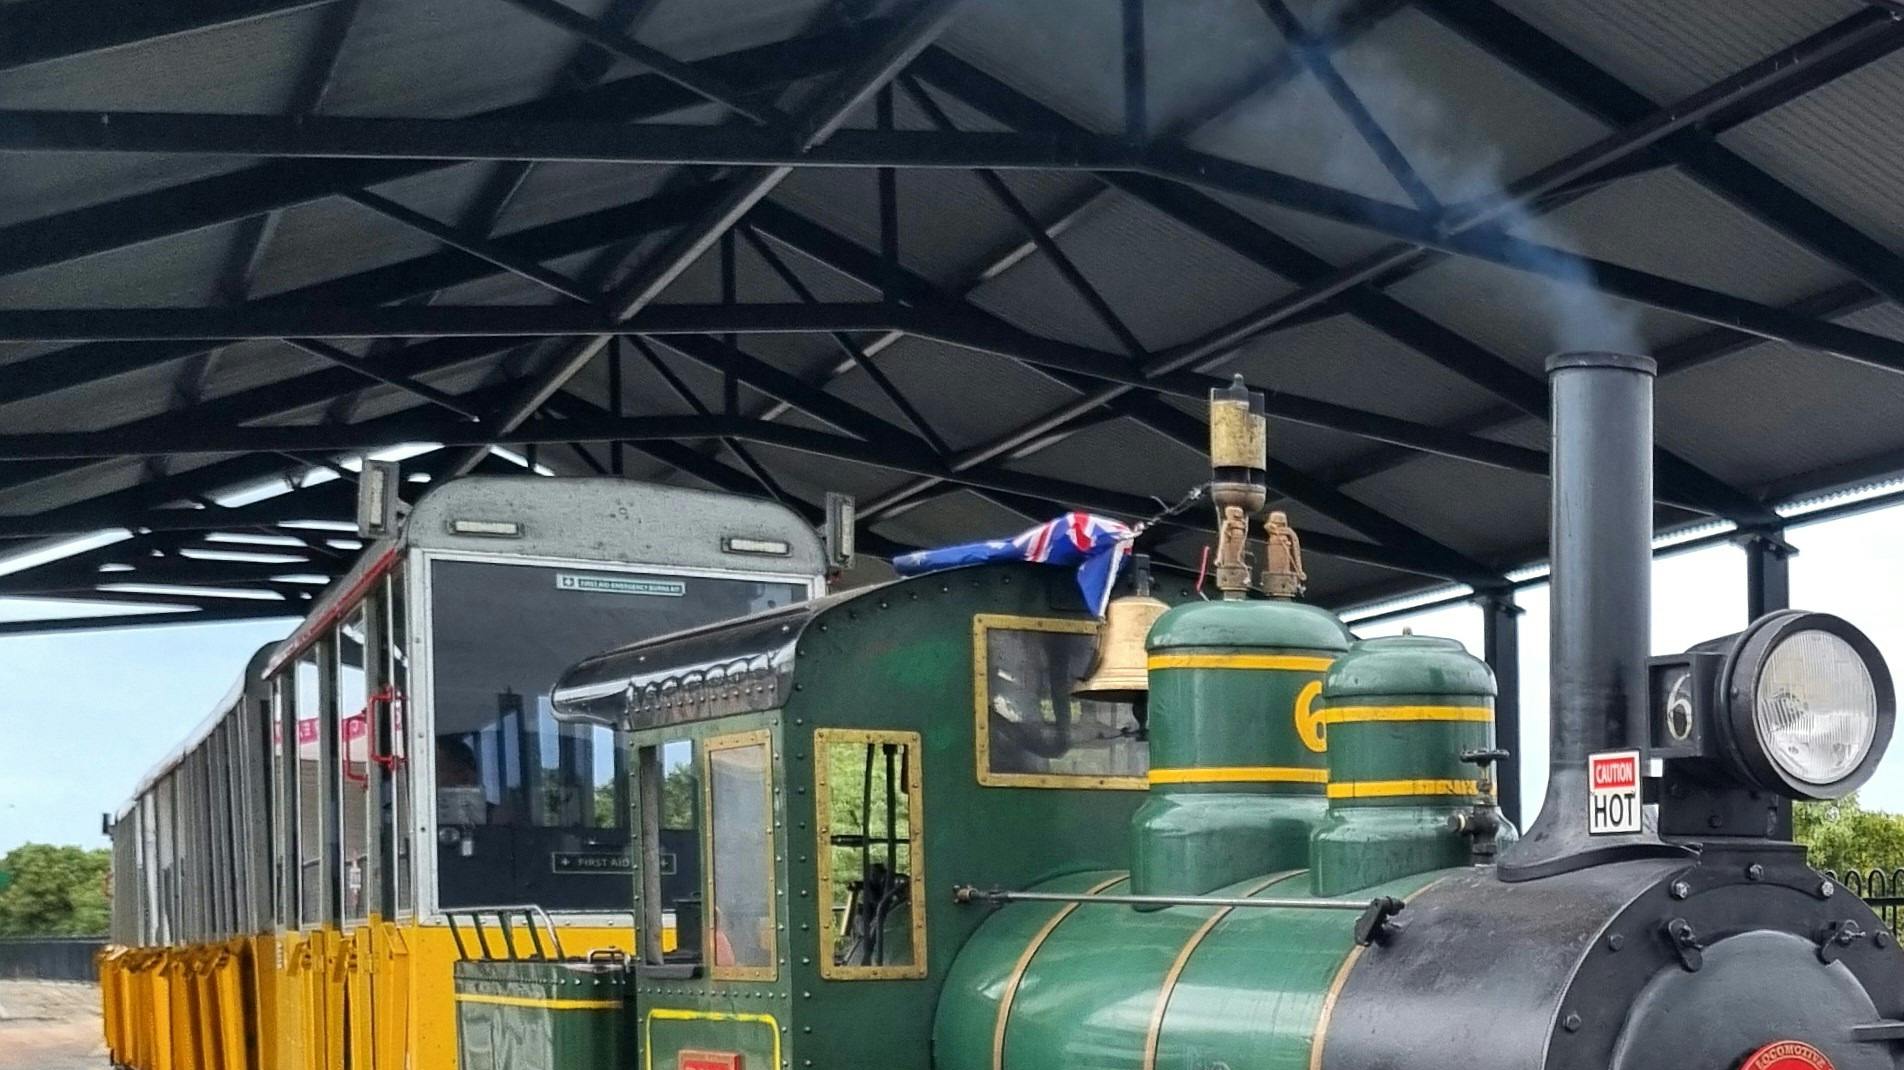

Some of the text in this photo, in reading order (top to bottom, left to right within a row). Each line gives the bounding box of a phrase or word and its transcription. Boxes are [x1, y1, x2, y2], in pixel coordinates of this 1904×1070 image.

[1294, 680, 1328, 753] 6
[1667, 672, 1693, 741] 6
[1596, 762, 1633, 784] CAUTION
[1594, 794, 1635, 828] HOT
[577, 858, 630, 867] FIRST AID
[1755, 1044, 1826, 1069] LOCOMOTIVE
